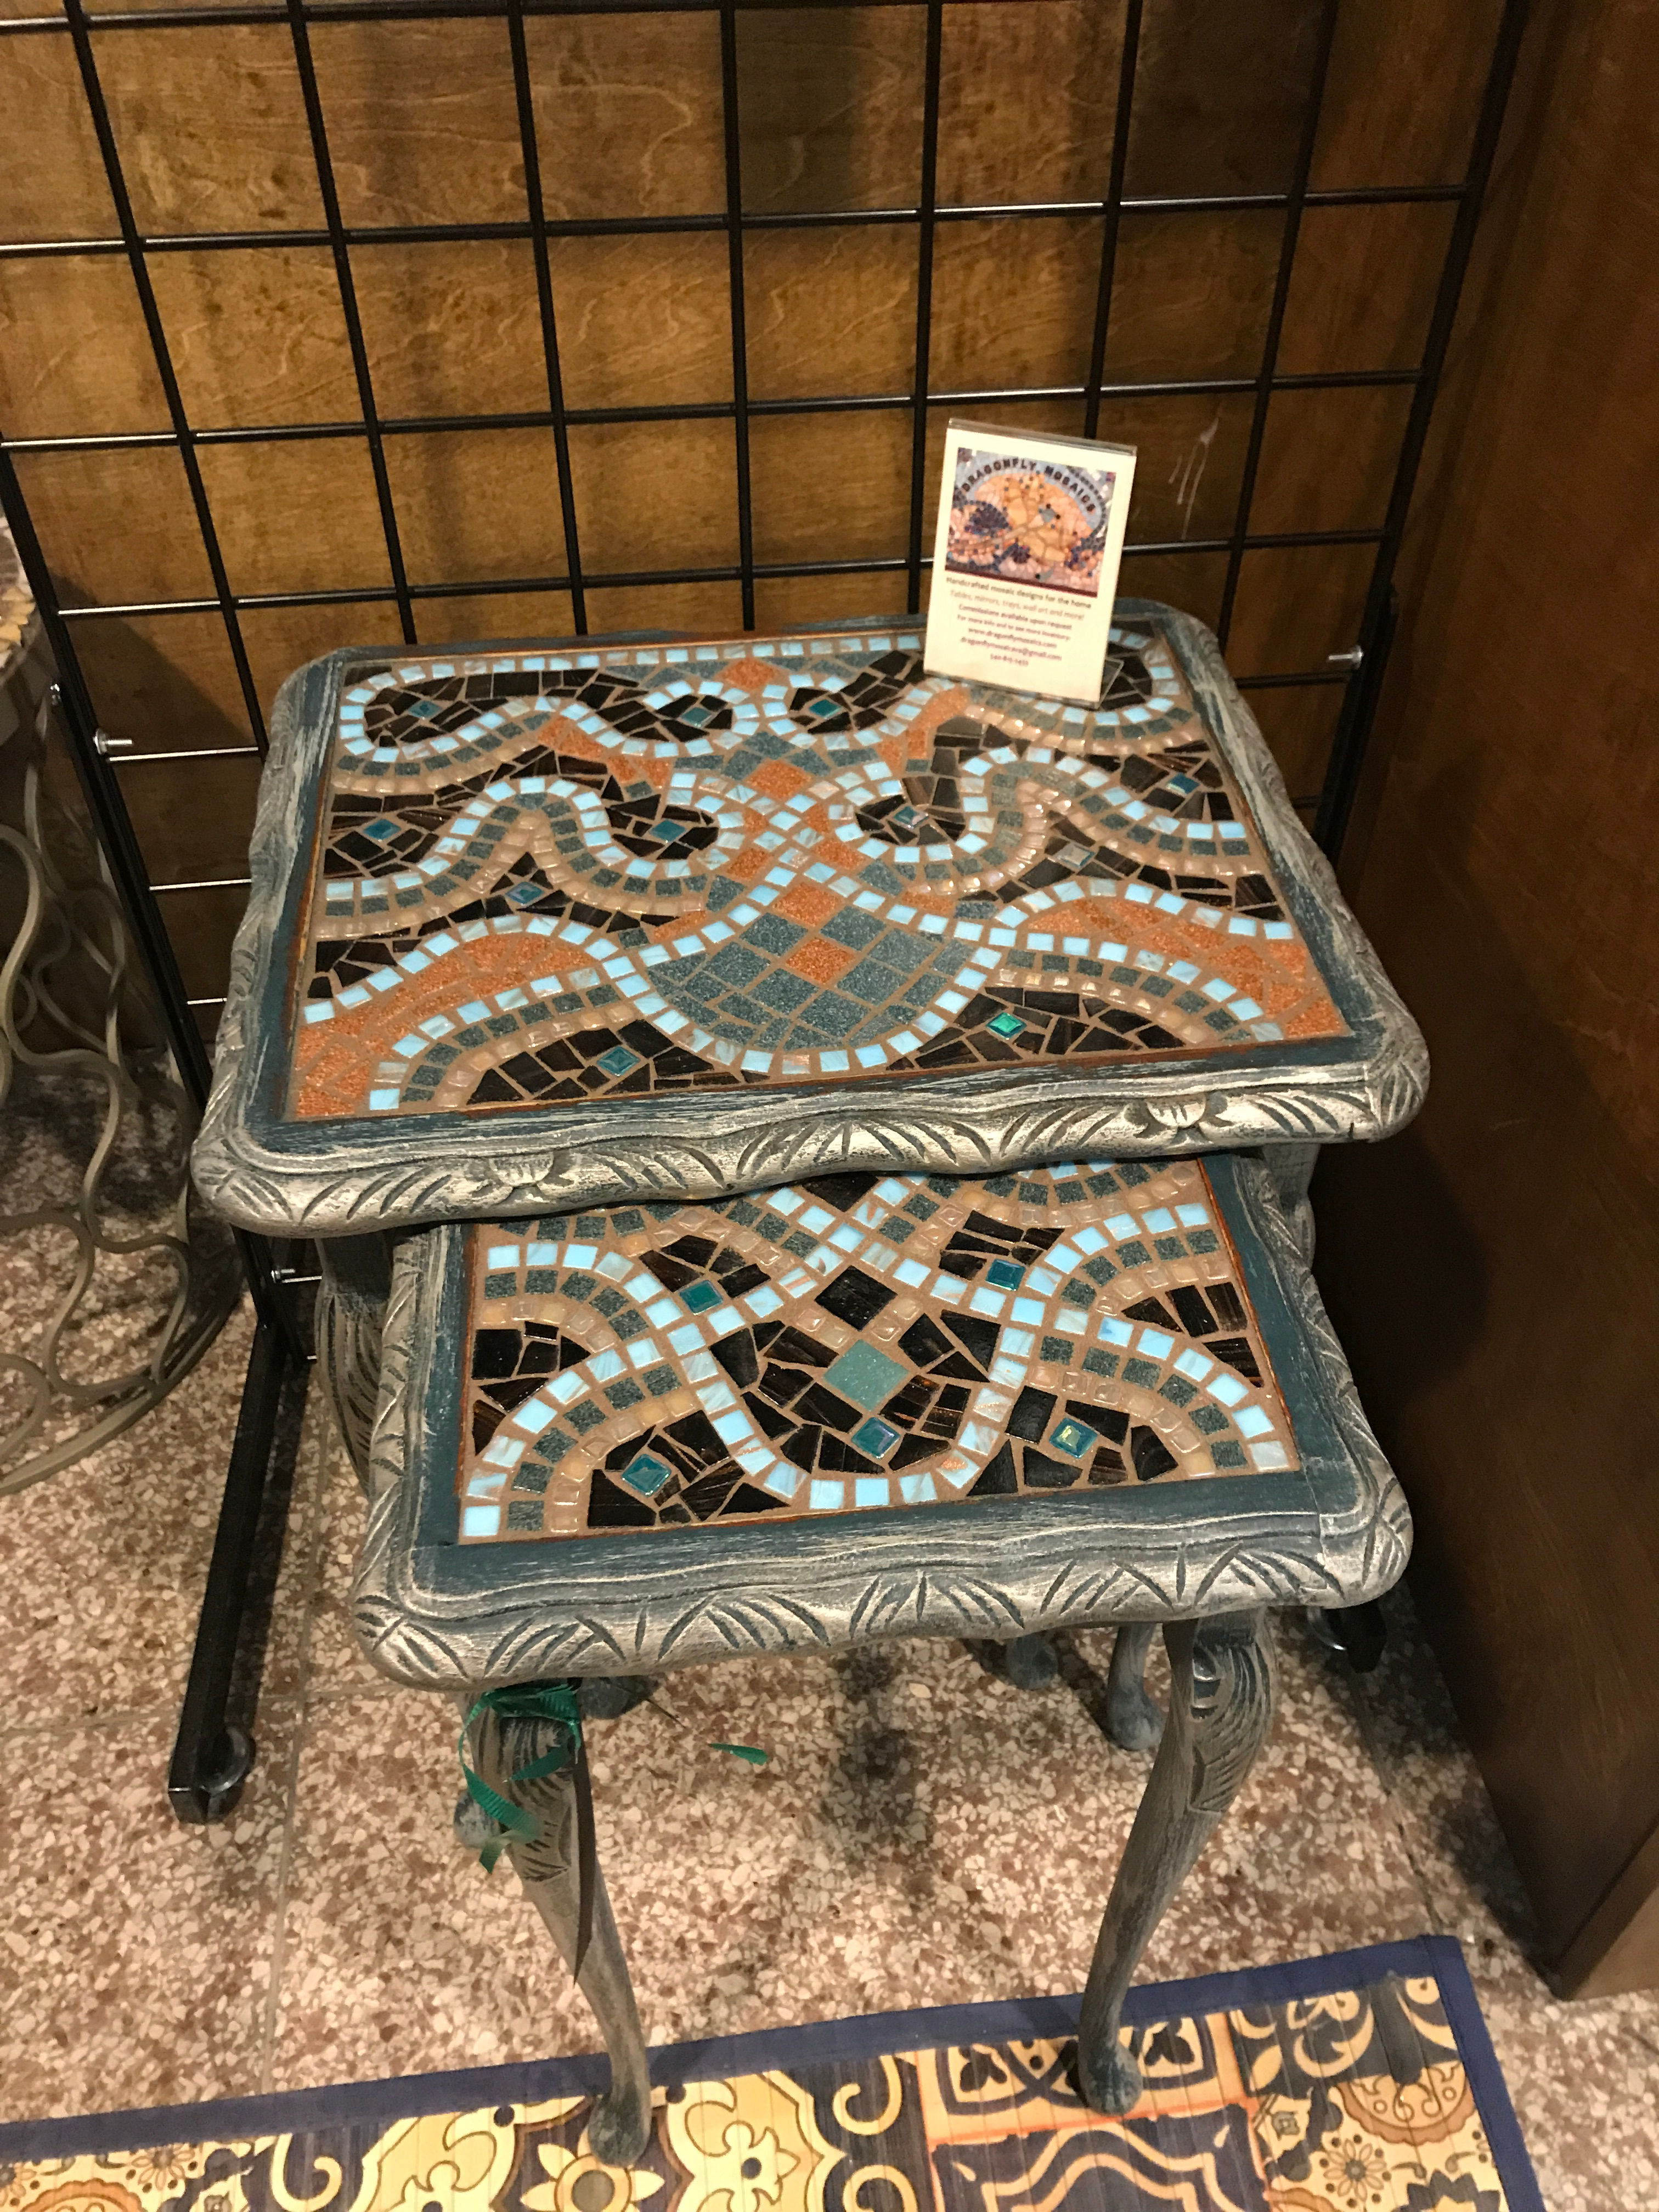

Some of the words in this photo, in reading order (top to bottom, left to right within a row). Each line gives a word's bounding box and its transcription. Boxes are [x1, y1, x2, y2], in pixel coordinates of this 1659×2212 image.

[962, 458, 1037, 492] DRAGONFLY
[1045, 465, 1096, 512] MOSAICS
[946, 577, 989, 590] Handcrafted
[991, 585, 1014, 595] mosaic
[1017, 590, 1043, 600] designs
[1058, 597, 1069, 605] the
[1071, 600, 1091, 608] home
[1001, 613, 1028, 622] available
[1048, 622, 1072, 630] request
